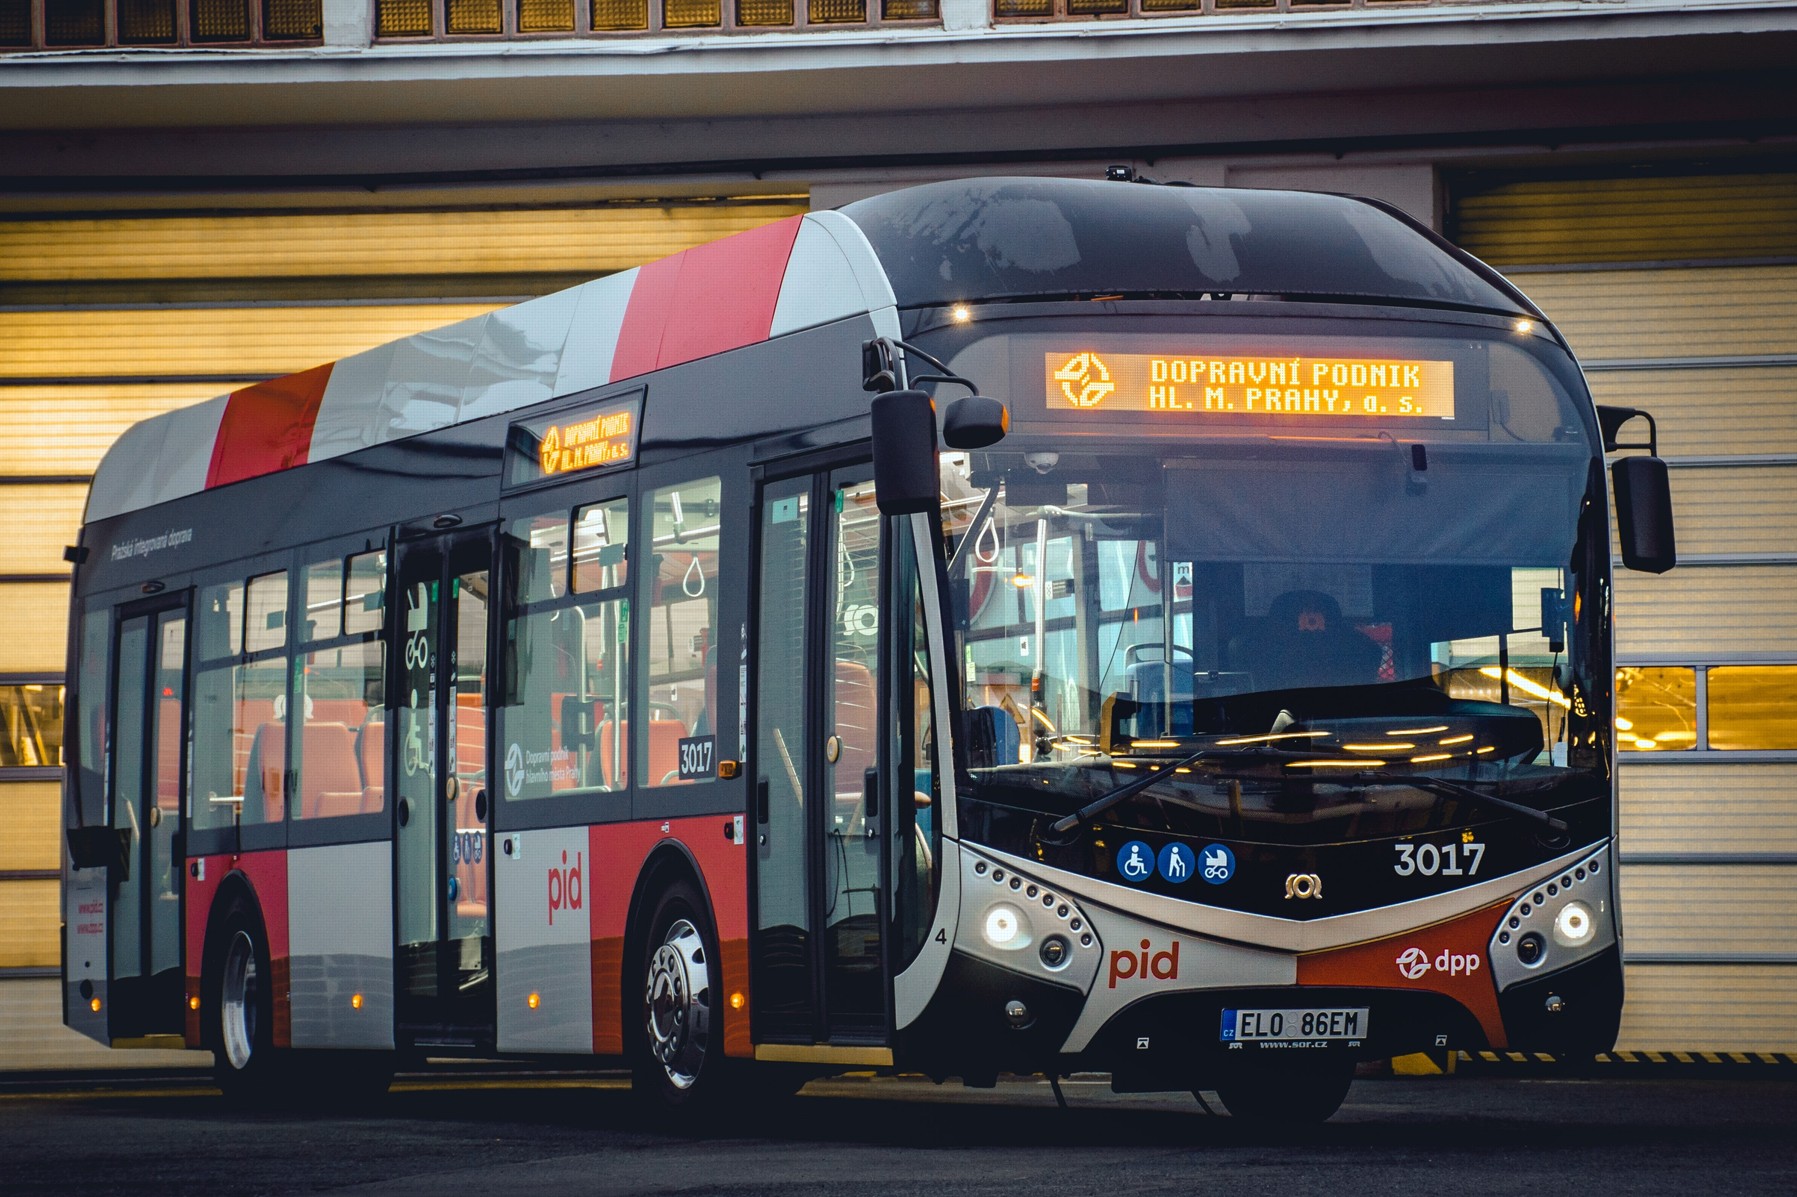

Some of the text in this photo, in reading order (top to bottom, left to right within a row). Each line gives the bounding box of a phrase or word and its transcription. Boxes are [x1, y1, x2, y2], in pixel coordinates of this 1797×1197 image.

[1152, 357, 1420, 387] DOPRAVNÍ PODNIK
[1150, 386, 1423, 413] HL. M. PRAHY, a. s.
[681, 741, 713, 774] 3017
[1394, 843, 1486, 877] 3017
[548, 850, 582, 926] pid
[935, 927, 947, 945] 4
[1108, 939, 1180, 989] pid
[1435, 949, 1481, 977] dpp
[1223, 1029, 1234, 1037] CZ
[1301, 1011, 1359, 1036] 86EM
[1260, 1040, 1328, 1049] www.sor.cz
